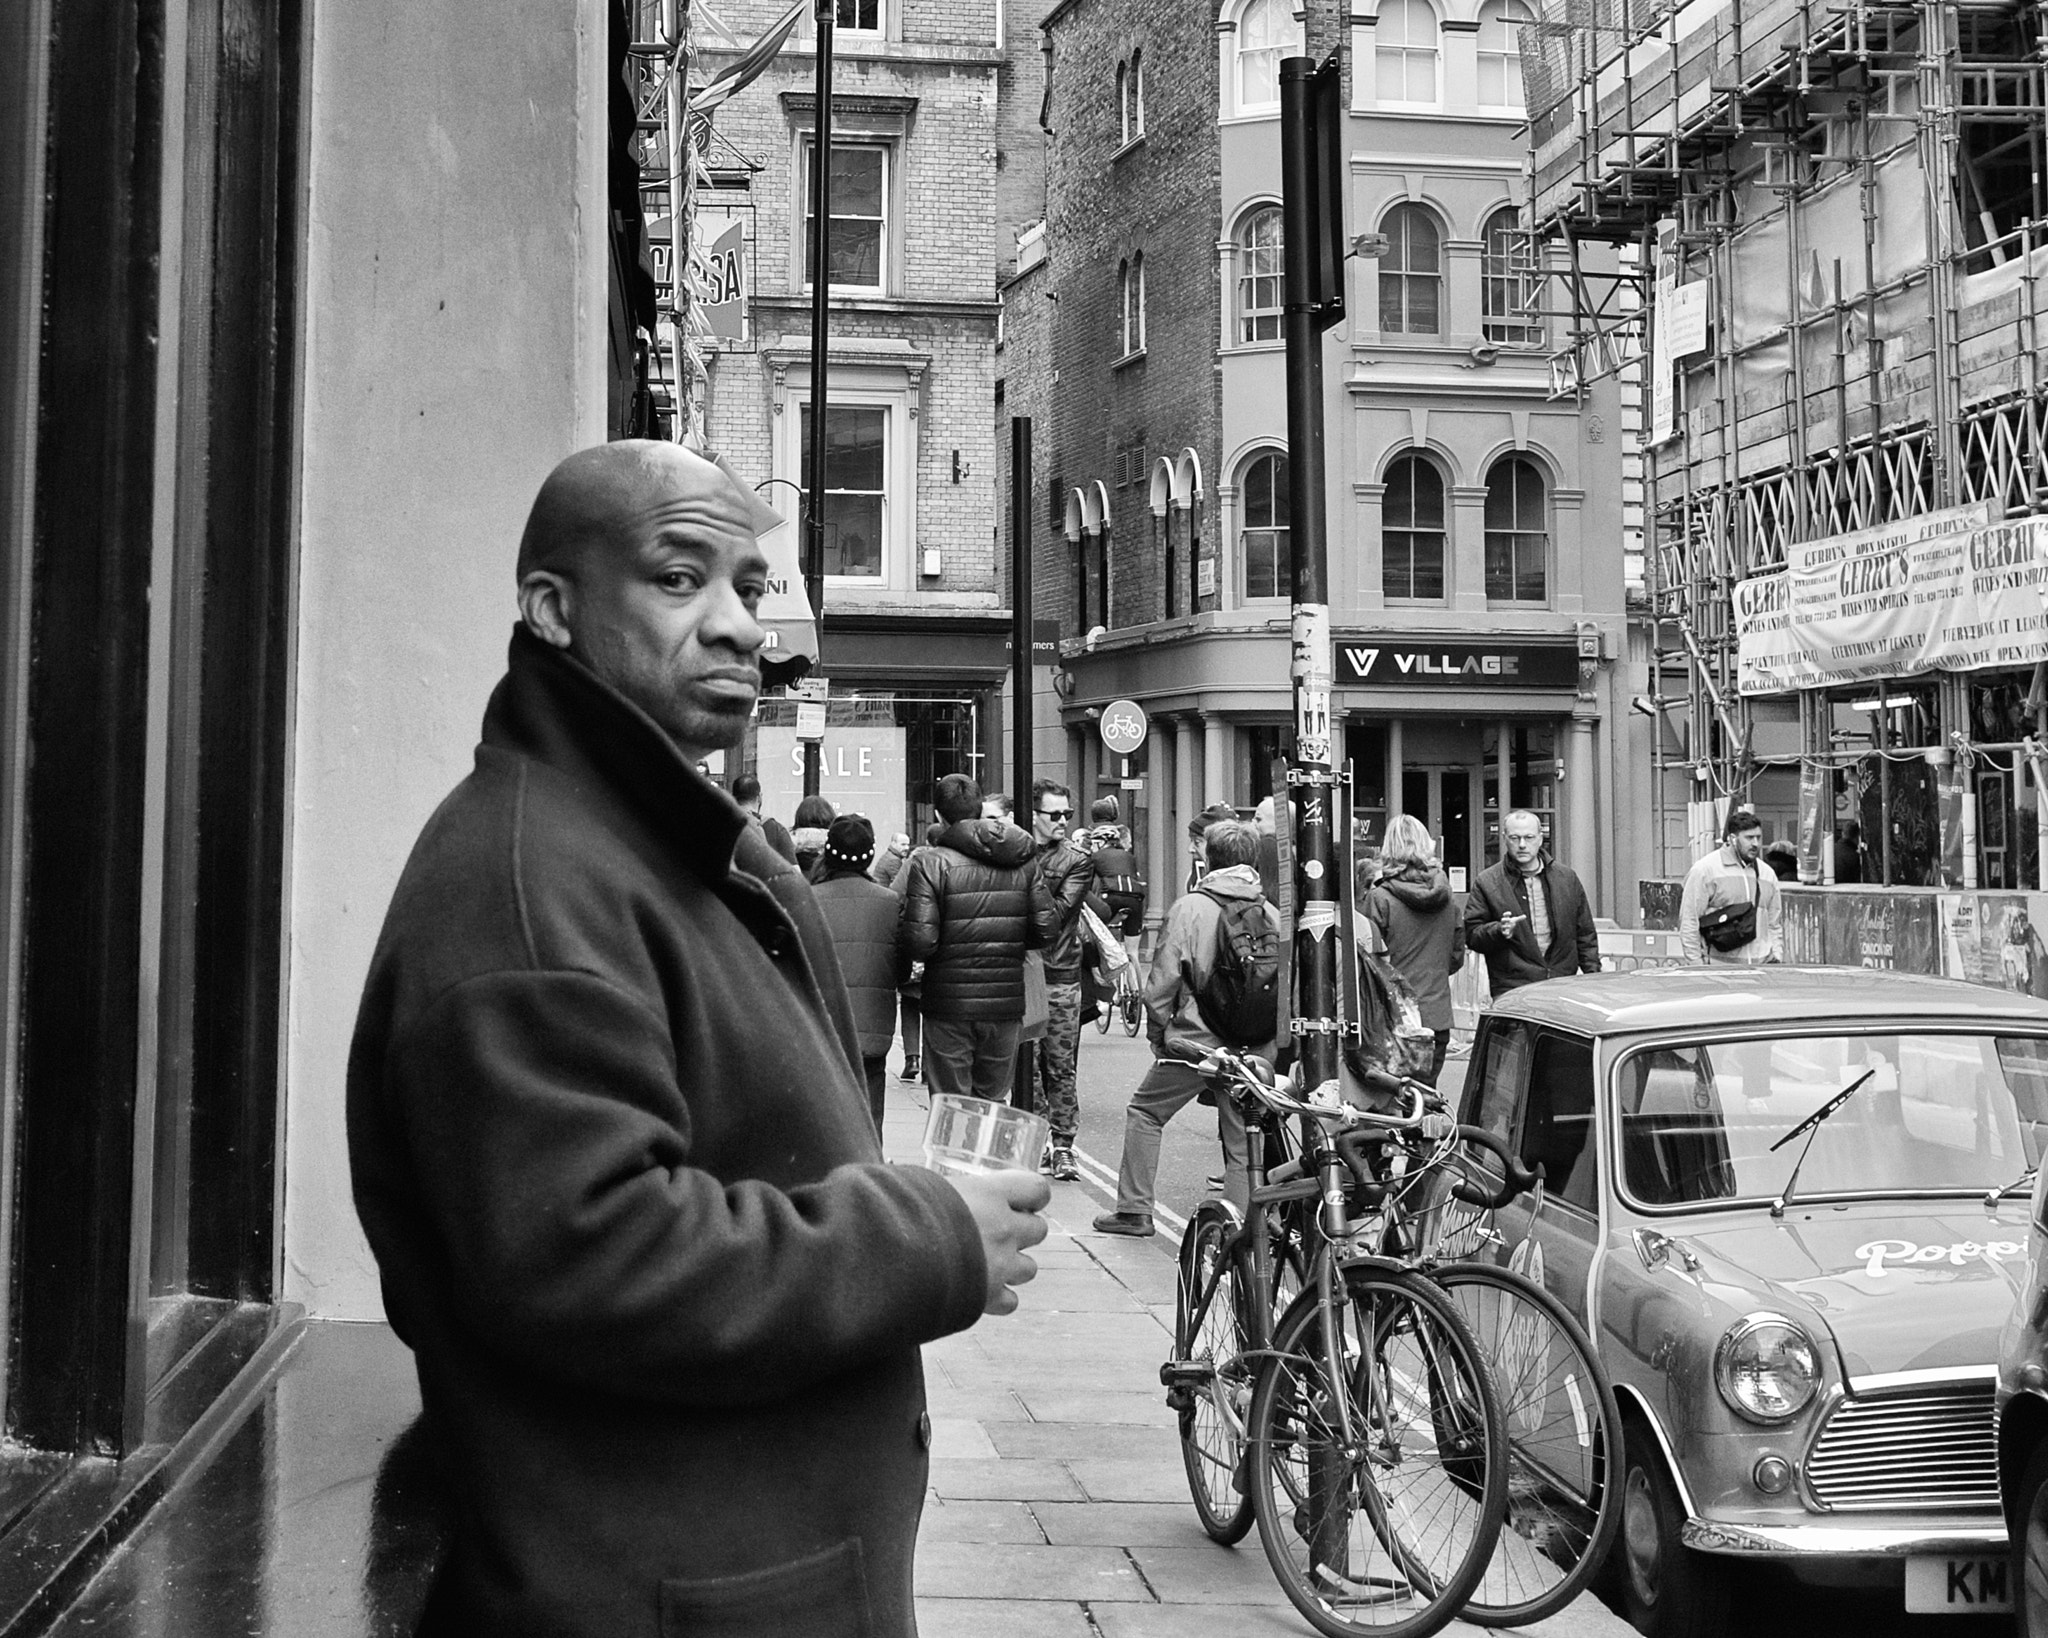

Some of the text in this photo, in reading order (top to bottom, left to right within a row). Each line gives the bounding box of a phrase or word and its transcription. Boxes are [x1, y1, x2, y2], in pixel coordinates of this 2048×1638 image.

[1840, 548, 1910, 598] GERRY'S
[1841, 591, 1909, 618] WINES AND SPIRITS
[1831, 640, 1875, 660] EVERYTHING
[1889, 634, 1915, 651] LEAST
[1393, 653, 1519, 675] VILLAGE
[791, 746, 872, 777] SALE
[1947, 1561, 2007, 1603] KM
